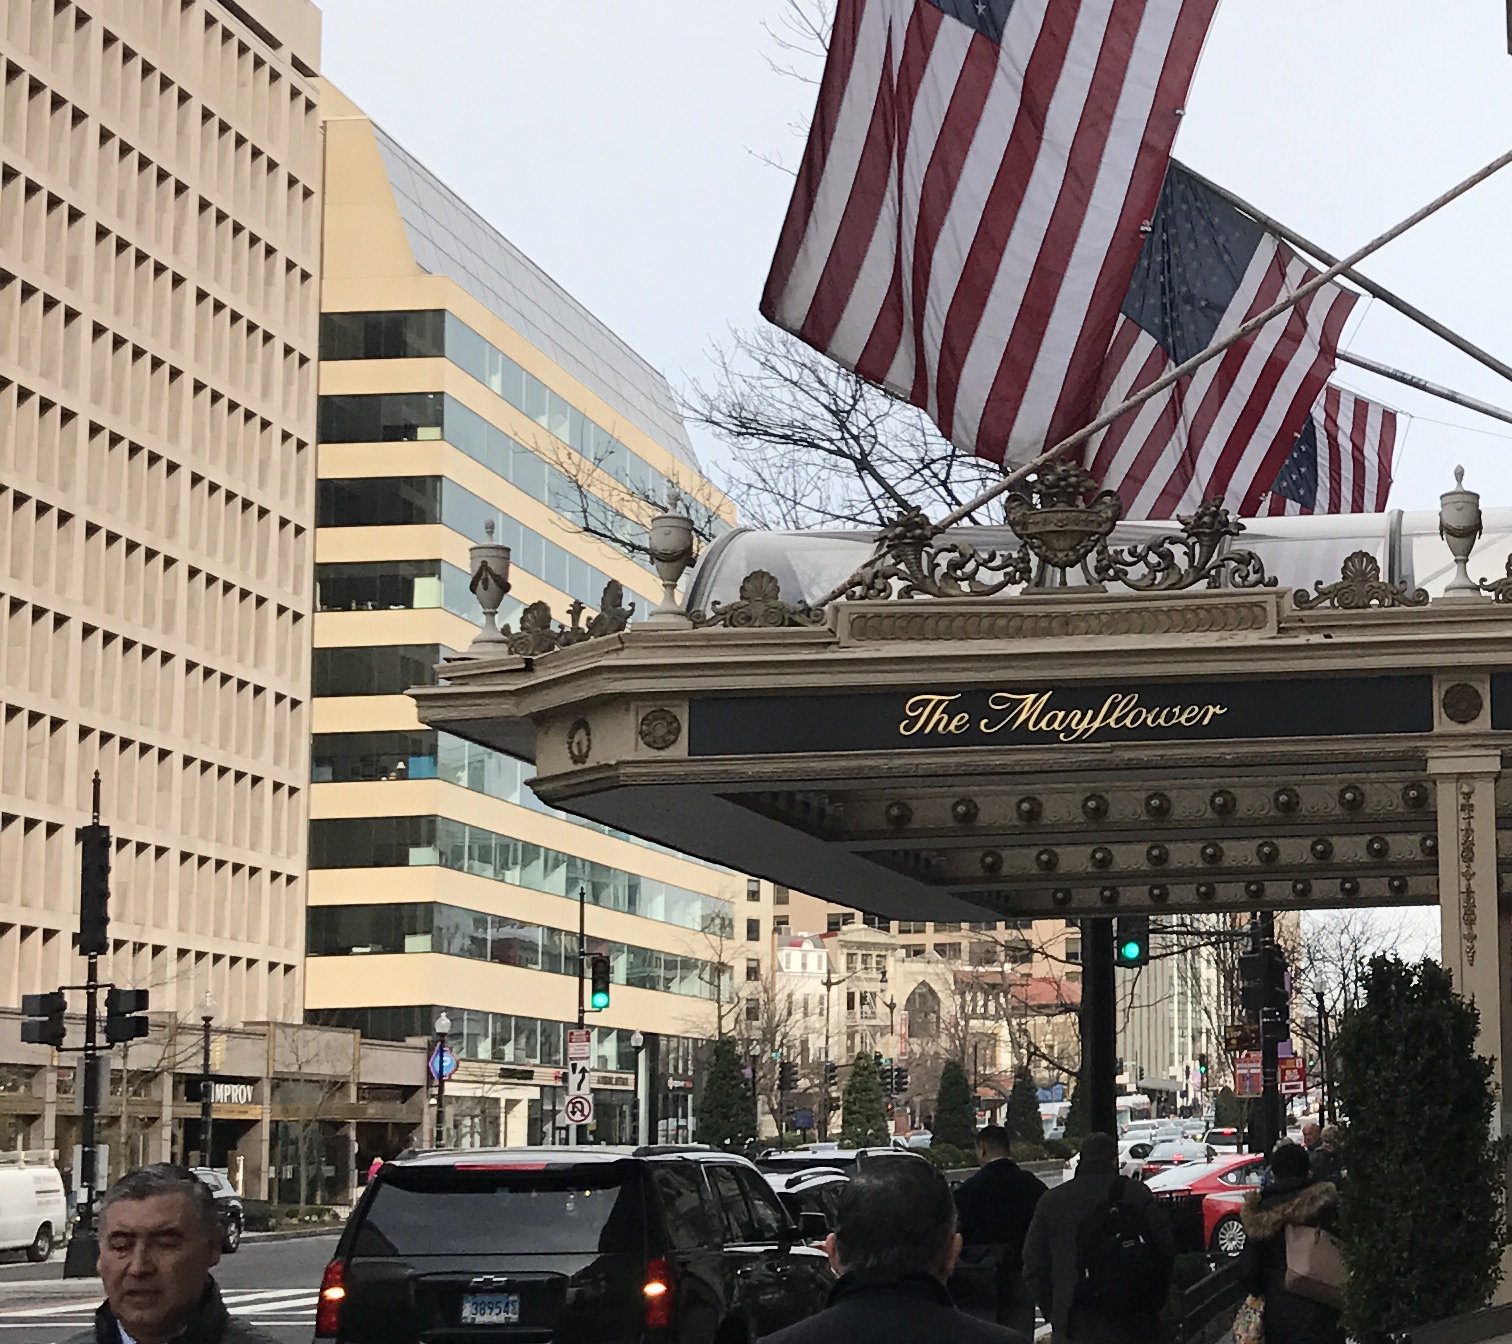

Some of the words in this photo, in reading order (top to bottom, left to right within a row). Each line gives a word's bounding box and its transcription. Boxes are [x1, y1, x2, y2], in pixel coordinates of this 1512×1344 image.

[900, 693, 969, 736] The
[979, 691, 1227, 742] Mayflower
[211, 1083, 253, 1104] IMPROV
